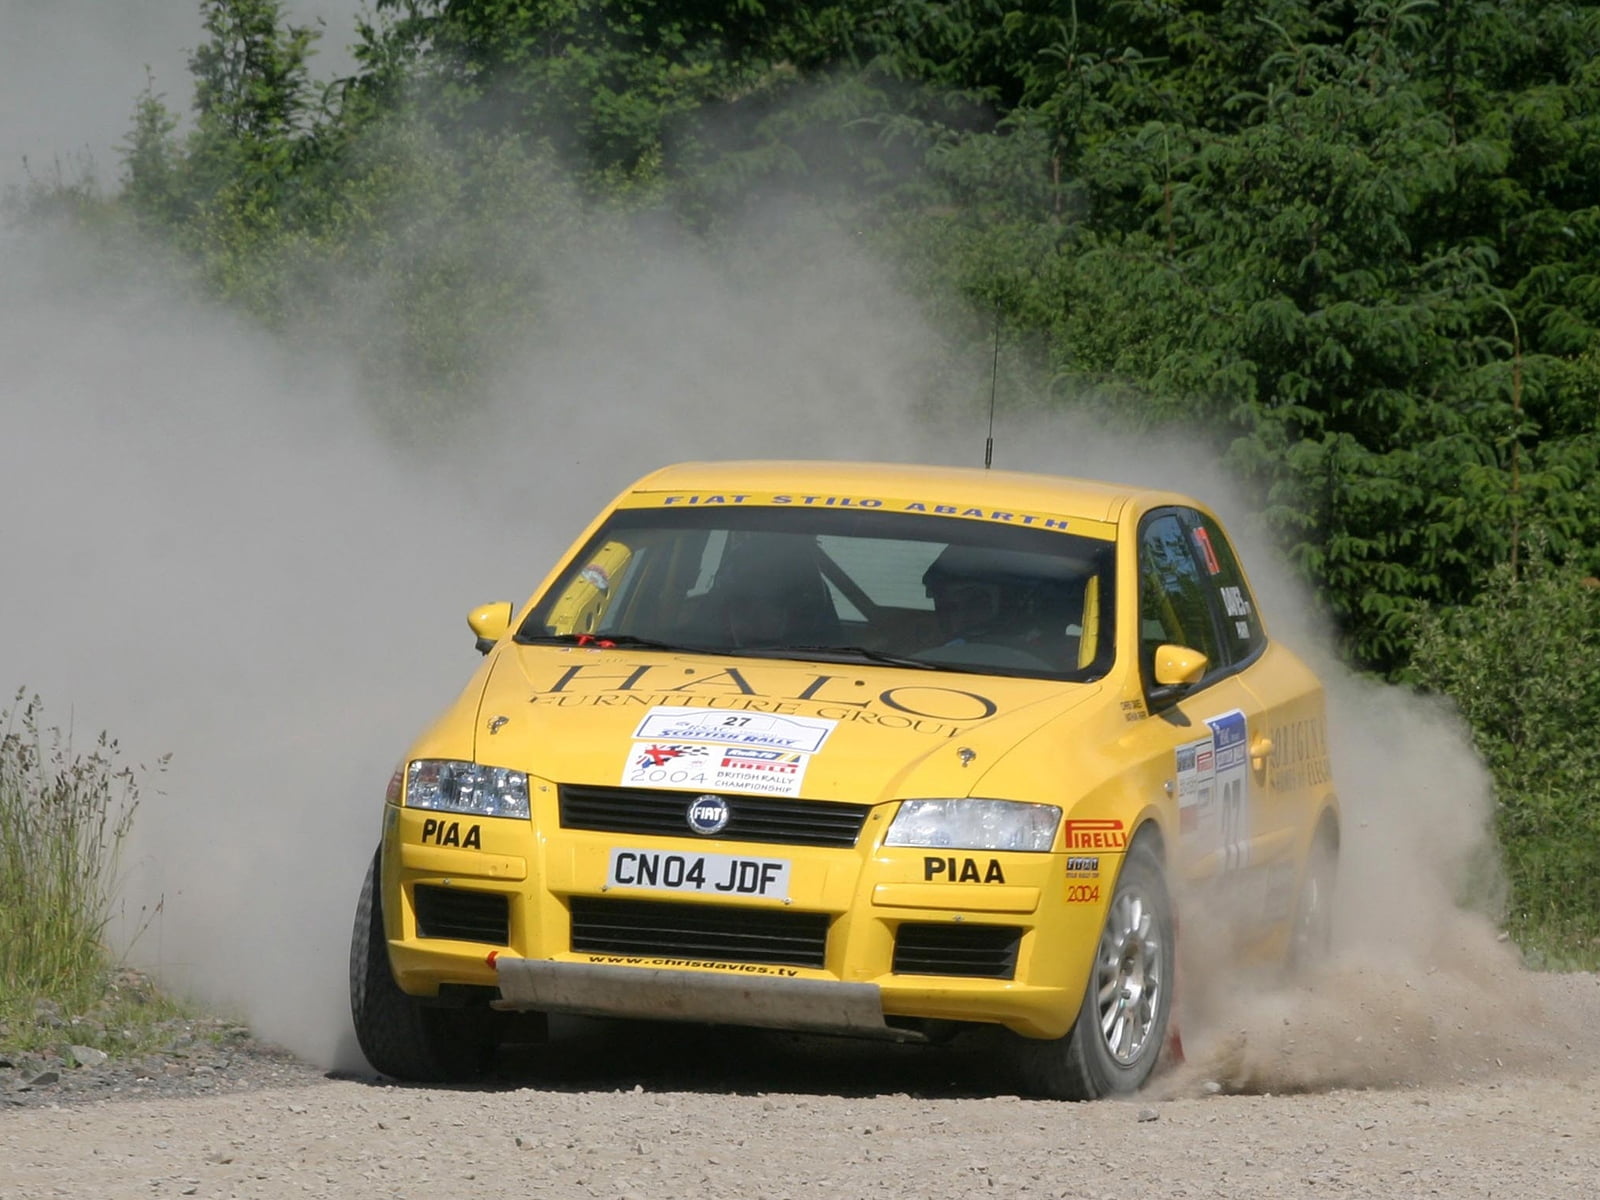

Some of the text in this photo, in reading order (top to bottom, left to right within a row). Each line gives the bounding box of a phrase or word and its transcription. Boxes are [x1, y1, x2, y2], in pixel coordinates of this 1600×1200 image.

[664, 494, 1070, 531] FIAT STILO ABARTH
[530, 693, 800, 714] FURNITURE
[723, 716, 752, 728] 27
[742, 735, 797, 746] RALLY
[630, 769, 709, 784] 2004
[714, 779, 793, 793] CHAMPIONSHIP
[716, 771, 796, 784] BRITISH RALLY
[693, 806, 722, 821] FIAT
[421, 818, 482, 850] PIAA
[1065, 819, 1128, 849] PIRELLI
[615, 852, 783, 895] CN04 JDF
[923, 856, 1006, 884] PIAA
[1067, 885, 1100, 902] 2004
[589, 955, 798, 977] www.chrisdavies.tv
